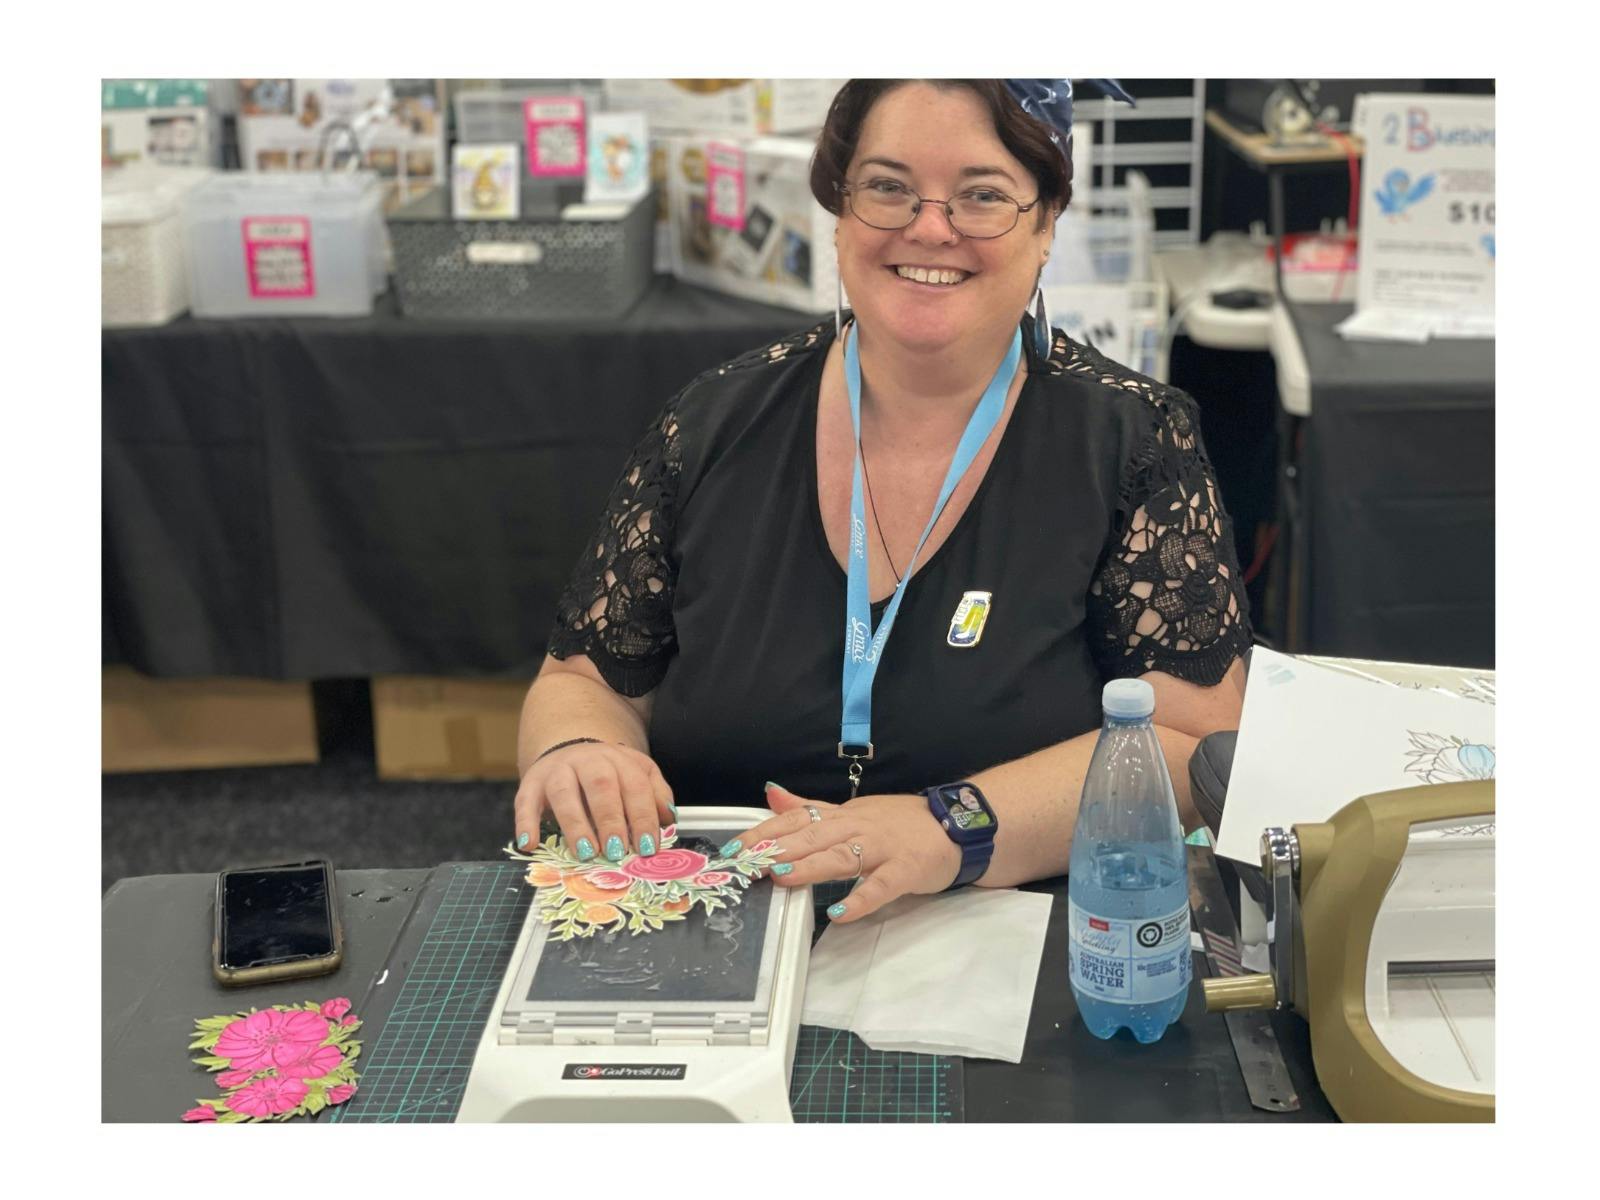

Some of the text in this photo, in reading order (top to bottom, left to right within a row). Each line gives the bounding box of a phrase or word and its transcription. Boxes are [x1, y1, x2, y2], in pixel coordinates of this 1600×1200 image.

[1382, 111, 1400, 145] 2
[853, 513, 866, 558] Grace
[852, 616, 870, 664] Grace
[1080, 960, 1125, 978] SPRING
[1081, 953, 1124, 968] AUSTRALIAN
[1080, 968, 1125, 989] WATER
